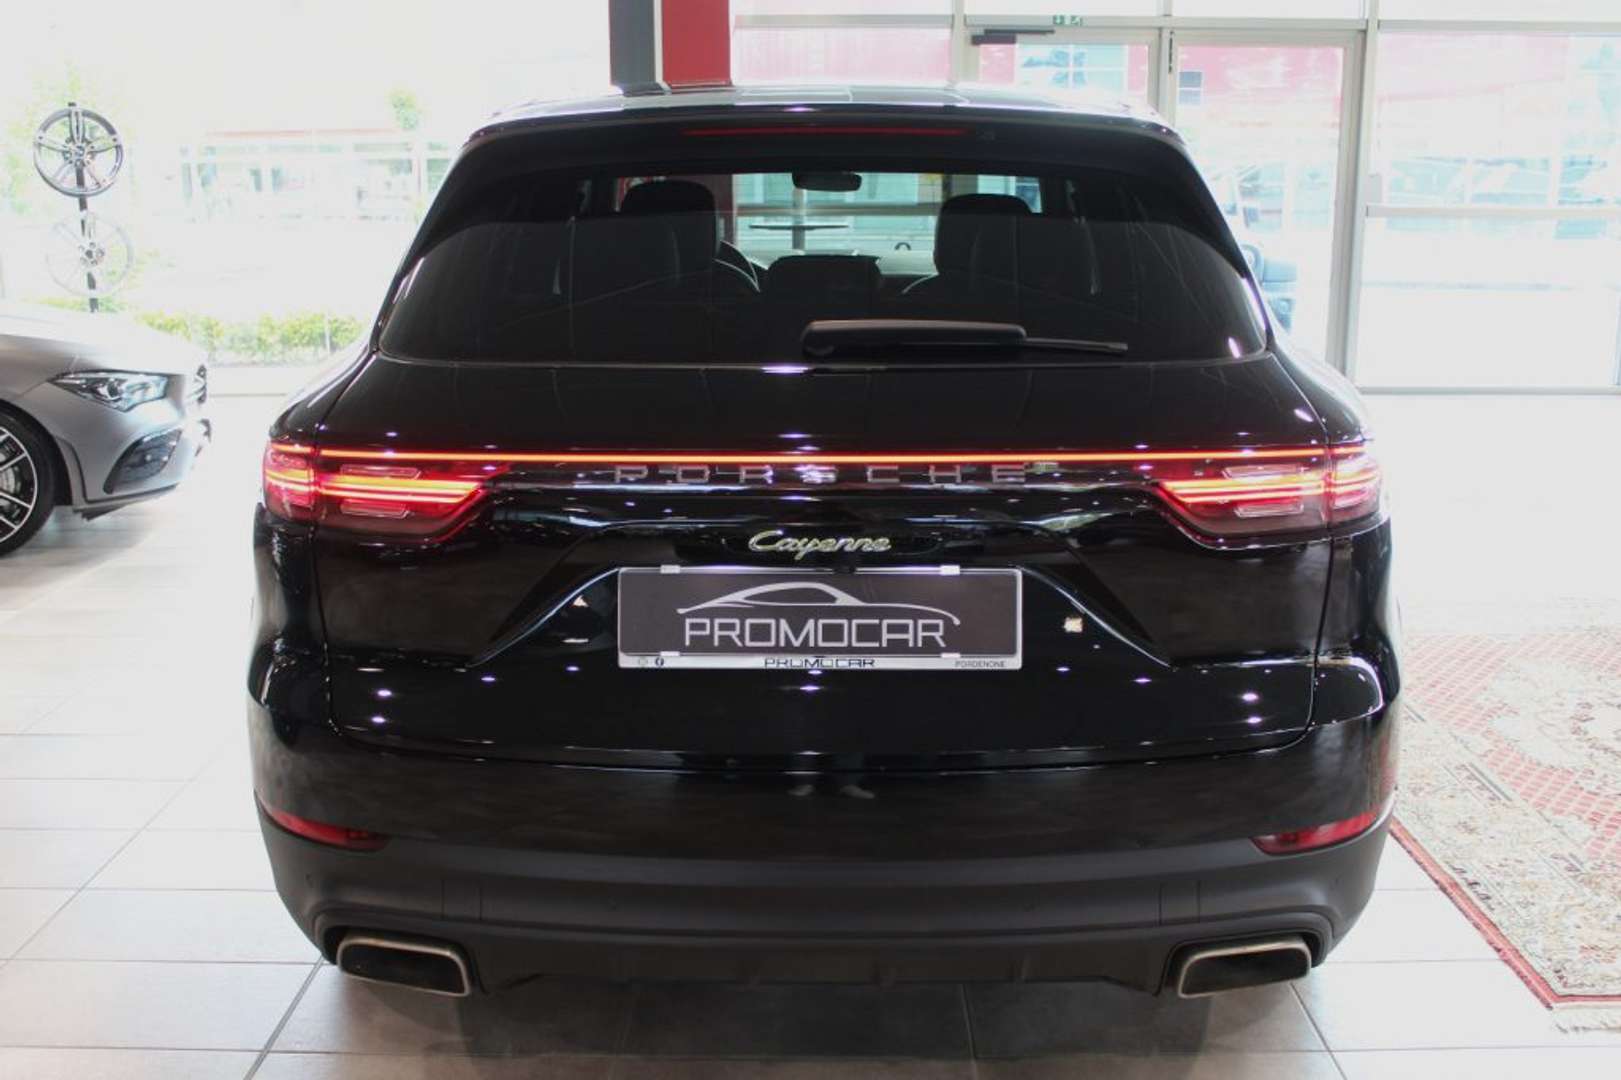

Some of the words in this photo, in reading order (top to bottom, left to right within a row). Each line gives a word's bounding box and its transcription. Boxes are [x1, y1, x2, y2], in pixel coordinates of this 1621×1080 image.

[614, 465, 1025, 484] PORSCHE
[748, 529, 892, 561] Cayenne
[685, 618, 946, 647] PROMOCAR
[764, 657, 875, 668] PROMOCAR
